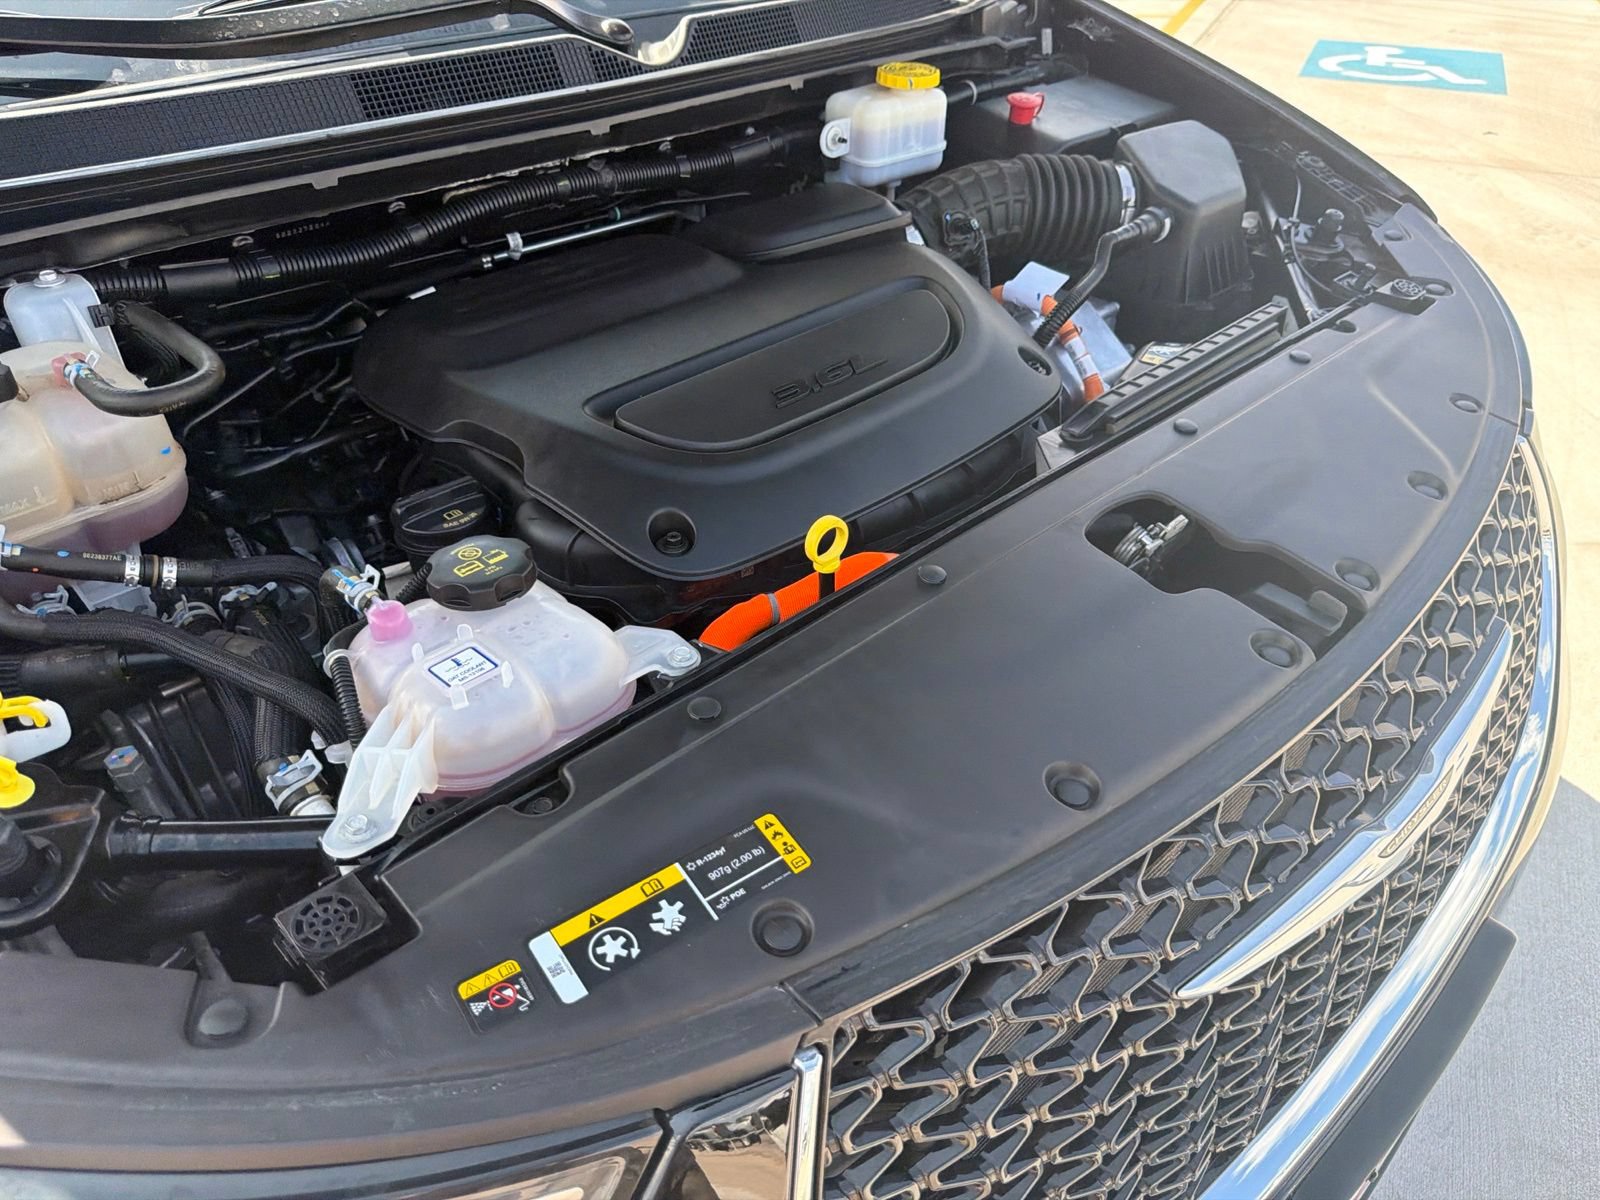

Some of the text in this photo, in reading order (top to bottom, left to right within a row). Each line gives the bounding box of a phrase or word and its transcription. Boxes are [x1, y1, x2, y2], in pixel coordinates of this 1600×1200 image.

[771, 357, 888, 409] 3.6L
[460, 660, 487, 677] COOLANT
[1387, 779, 1448, 853] CHRYSLER
[695, 846, 727, 867] R-1234yf
[707, 845, 766, 881] 907g (2.00 lb)
[729, 887, 747, 901] POE
